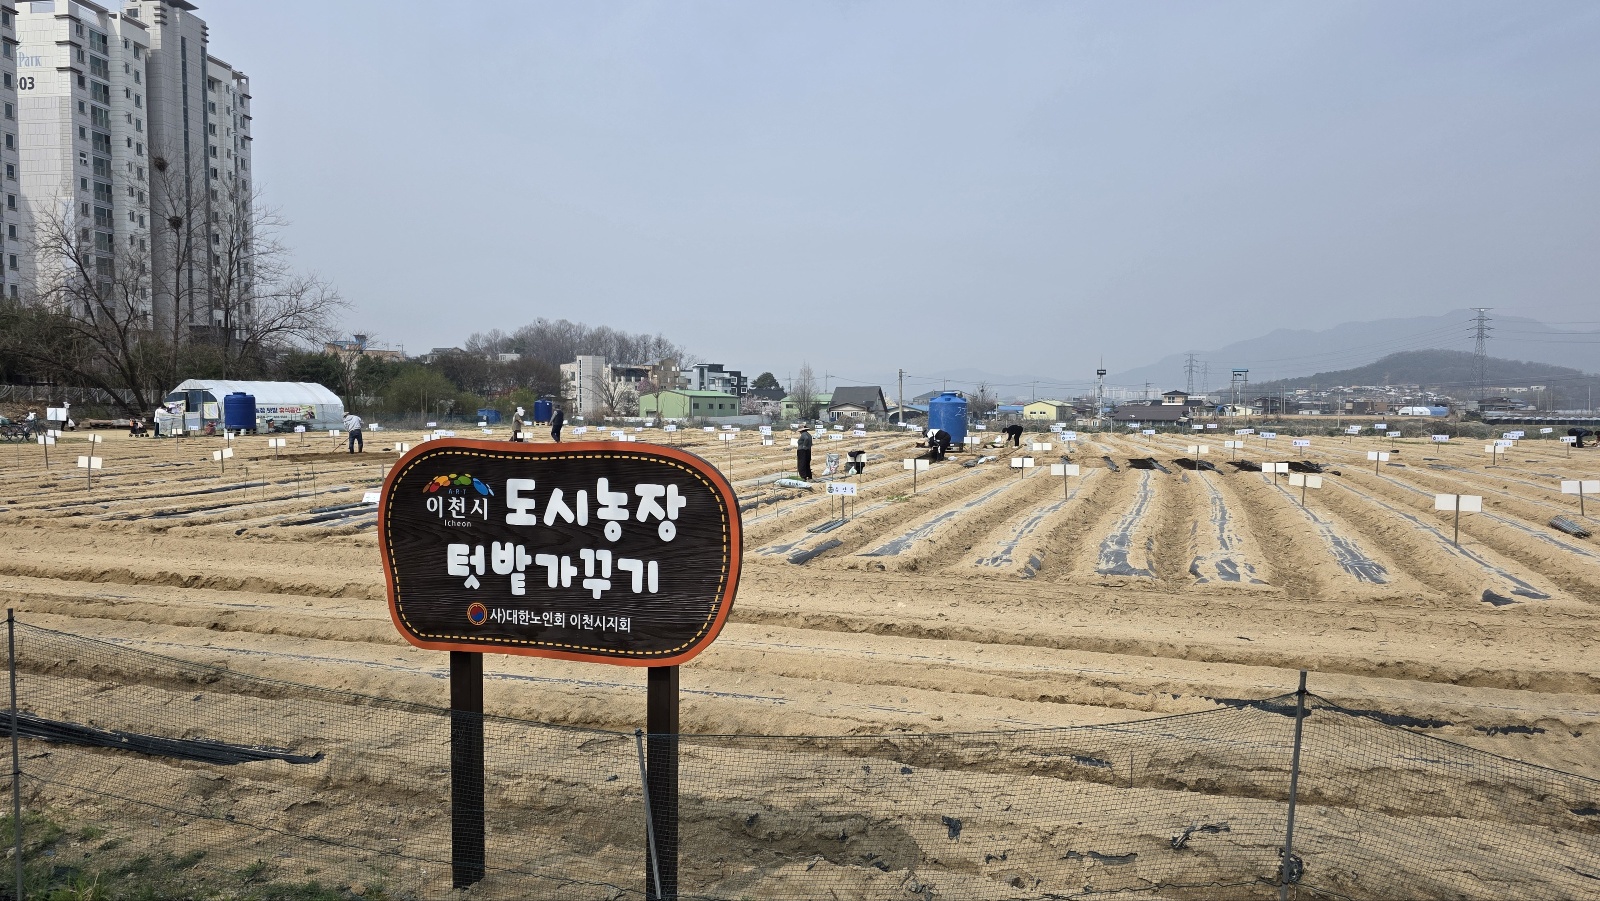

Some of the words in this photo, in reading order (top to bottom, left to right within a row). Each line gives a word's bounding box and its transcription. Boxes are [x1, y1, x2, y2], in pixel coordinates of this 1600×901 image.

[16, 76, 35, 91] 03
[426, 495, 488, 521] 이천시
[505, 477, 687, 542] 도시농장
[443, 519, 472, 528] Icheon
[447, 541, 660, 600] 텃밭가꾸기
[489, 607, 566, 629] 사)대한노인회
[569, 613, 631, 633] 이천시지회
